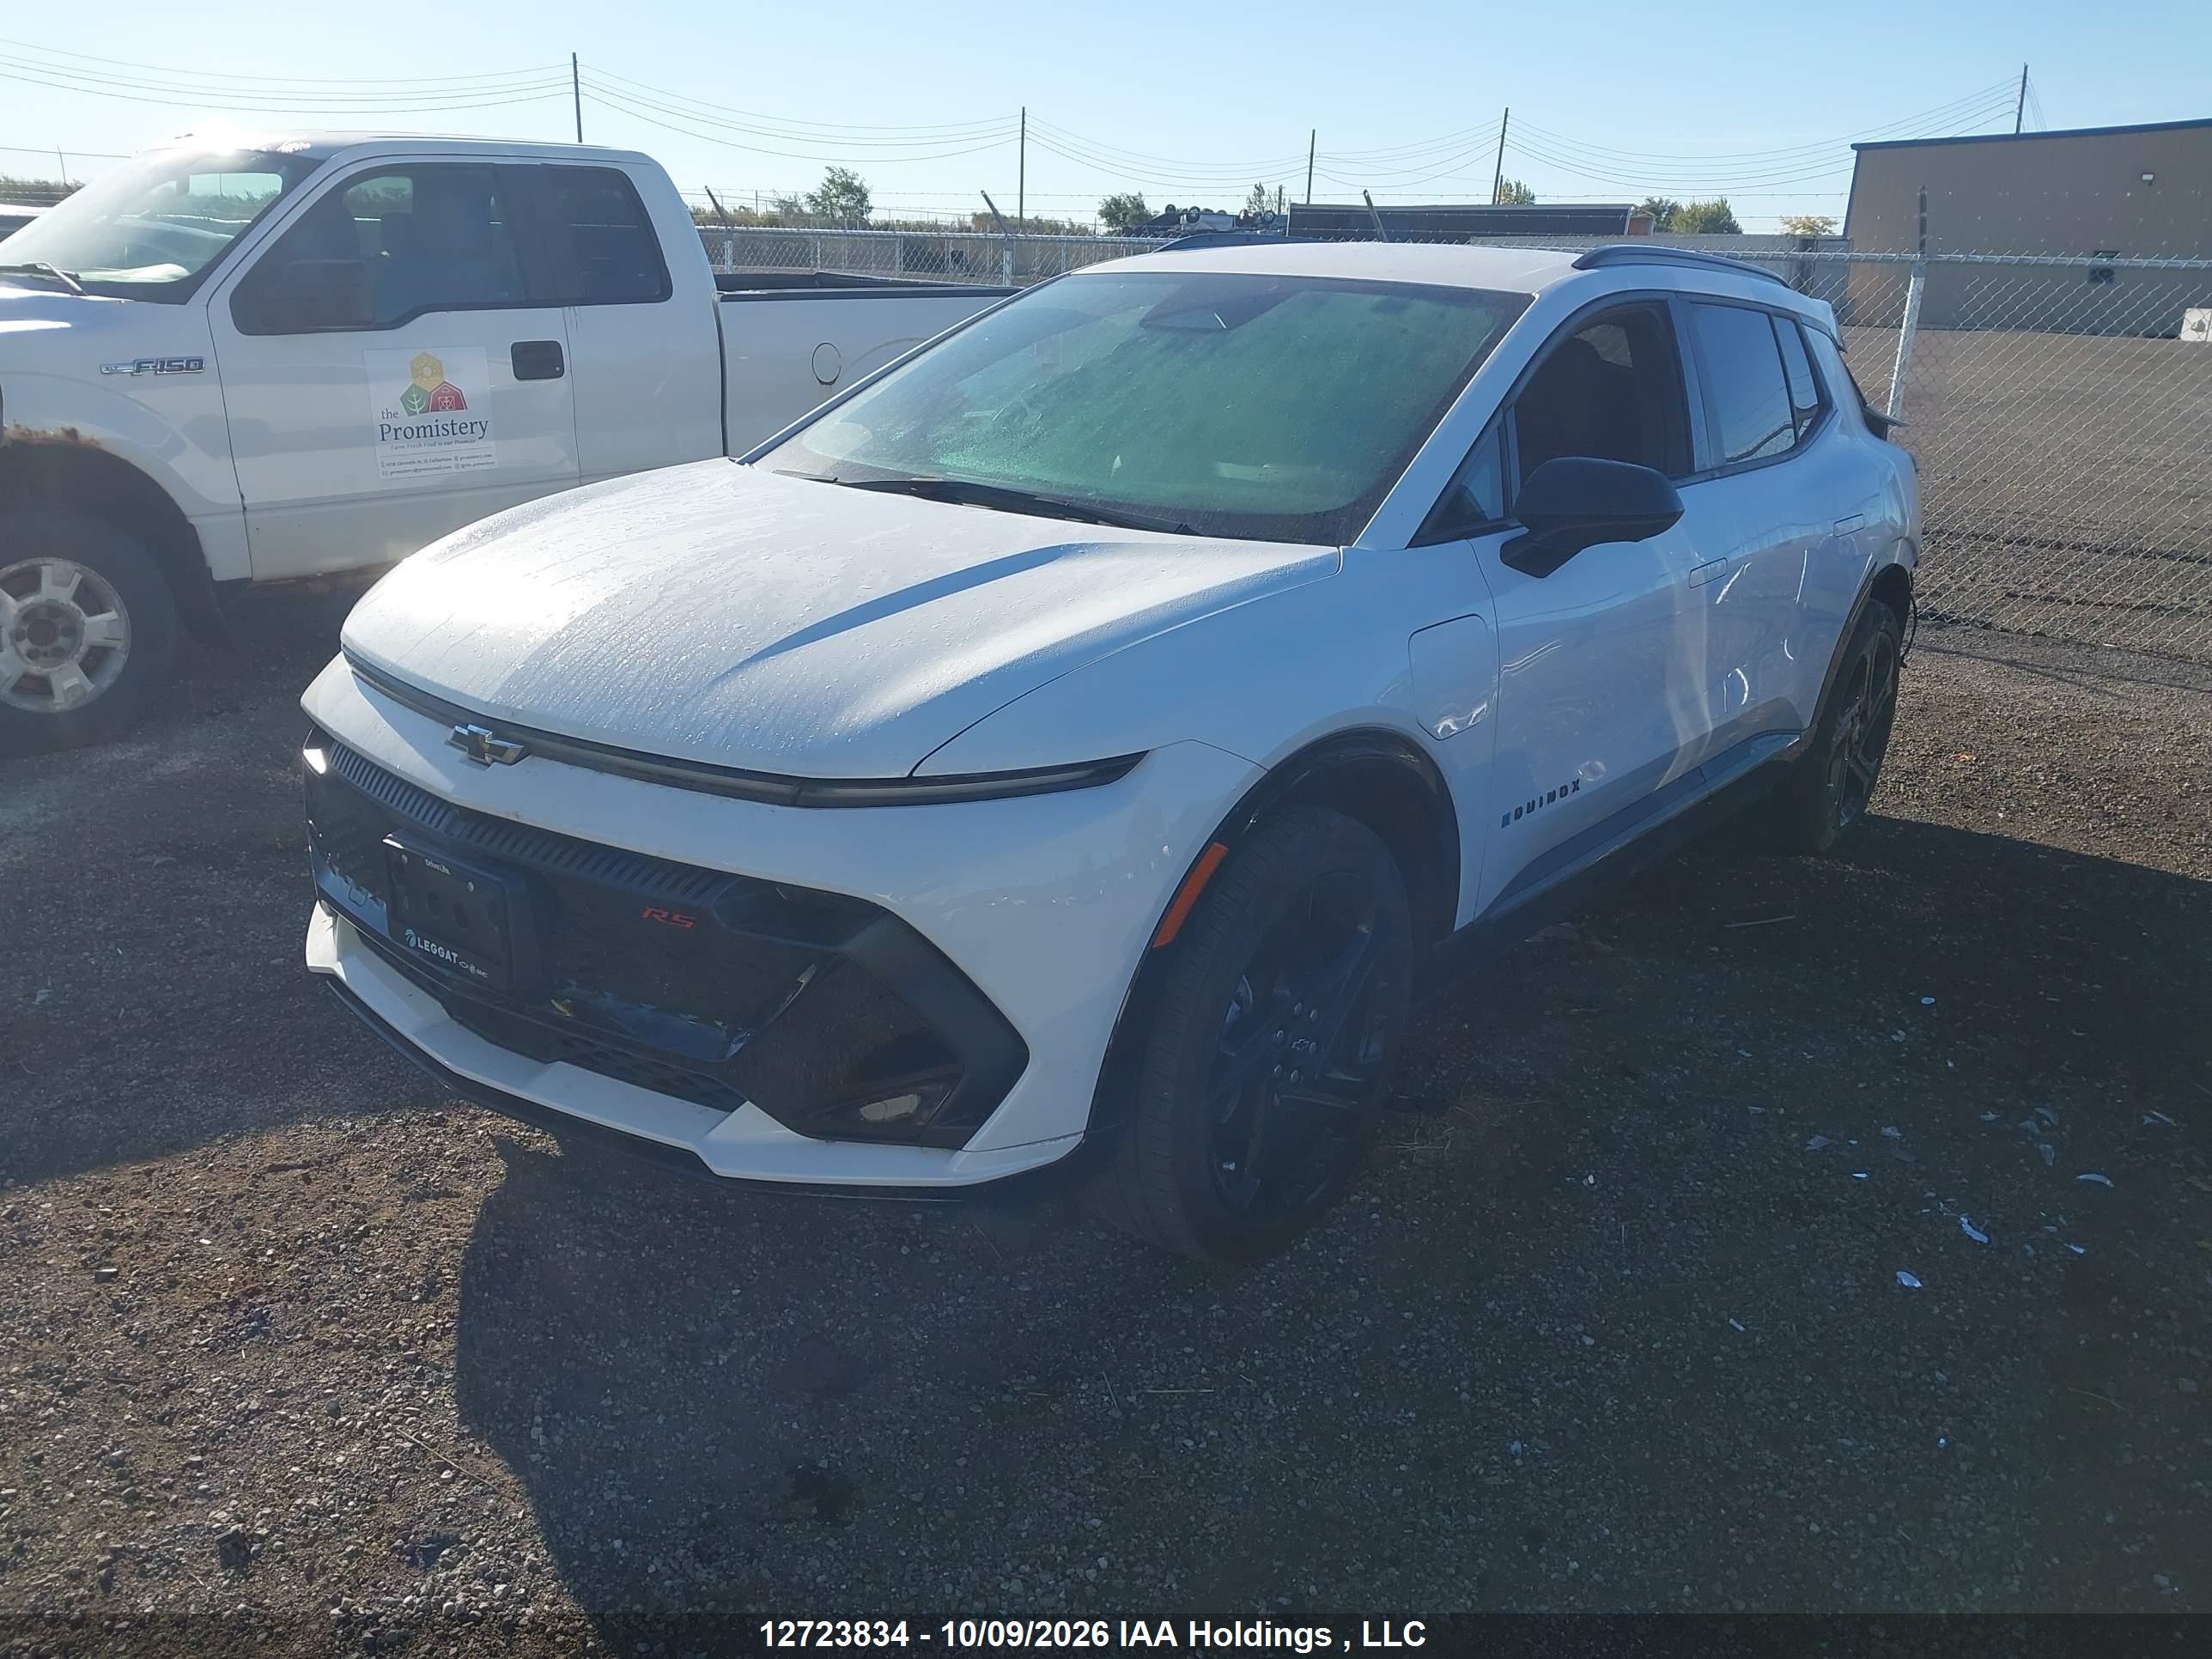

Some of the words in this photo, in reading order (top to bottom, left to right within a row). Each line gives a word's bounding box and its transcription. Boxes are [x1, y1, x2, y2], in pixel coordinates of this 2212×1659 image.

[133, 358, 204, 376] F-150
[381, 408, 399, 419] the
[379, 419, 489, 441] Promistery
[1501, 779, 1580, 829] EQUINOX
[641, 907, 696, 928] RS
[417, 936, 459, 963] LEGGAT
